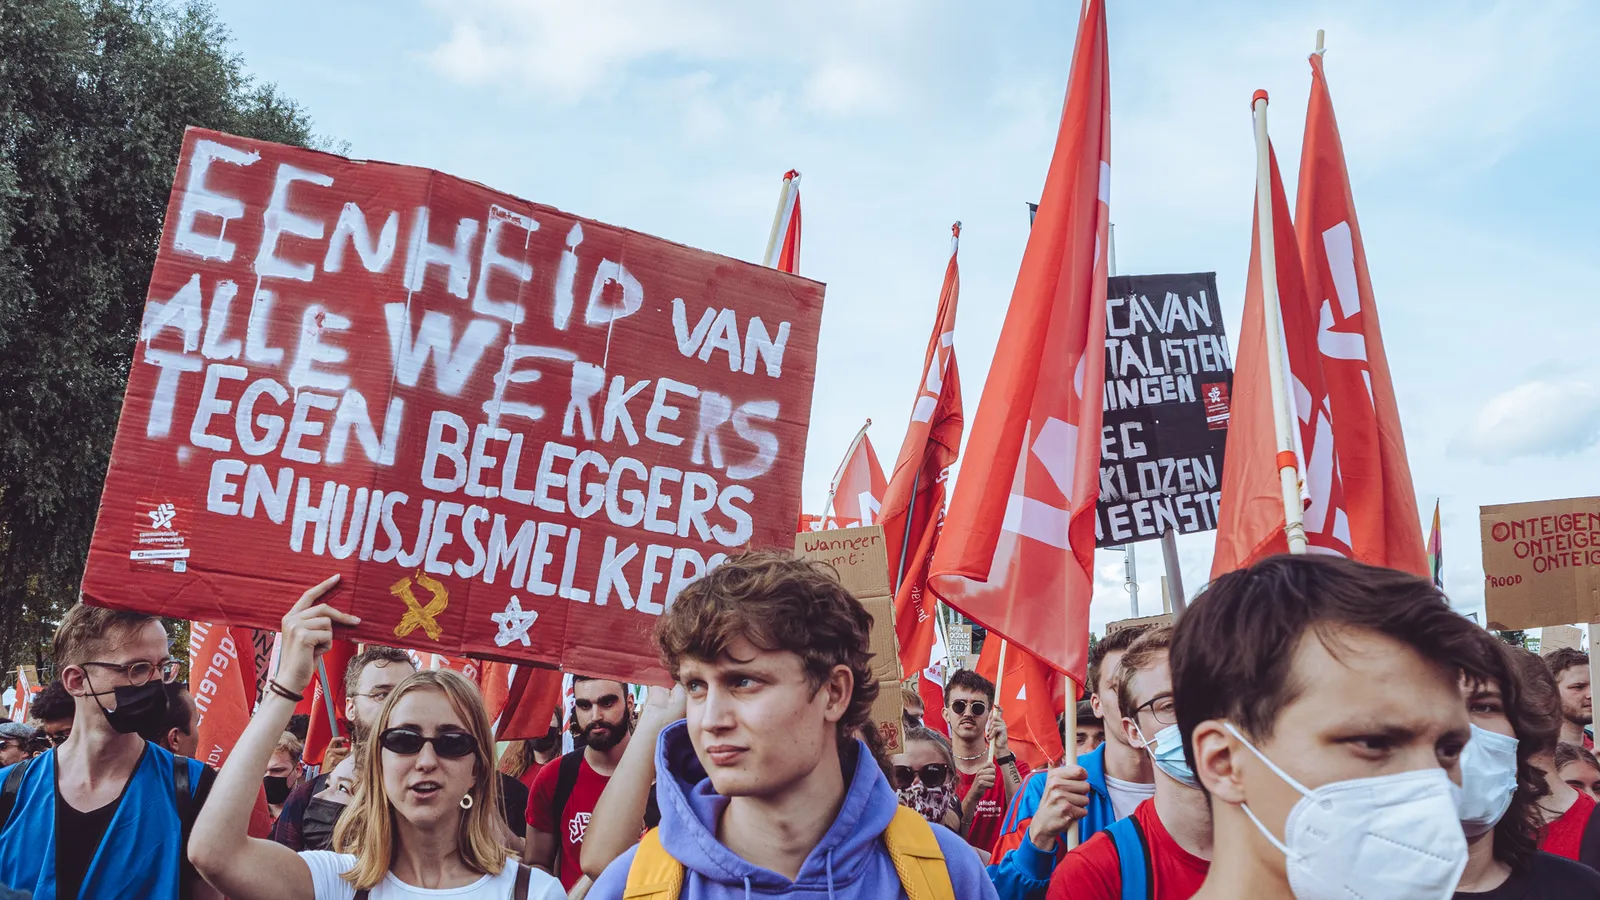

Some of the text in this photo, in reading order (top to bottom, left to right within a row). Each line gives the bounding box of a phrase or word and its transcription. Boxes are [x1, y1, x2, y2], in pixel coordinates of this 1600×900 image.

[672, 297, 790, 378] VAN
[1104, 334, 1232, 378] TALISTEN
[140, 272, 781, 480] ALLE WERKERS
[144, 348, 755, 547] TEGEN BELEGGERS
[1101, 421, 1147, 461] EG
[1098, 455, 1217, 502] KLOZEN
[1095, 491, 1221, 541] EENST
[1491, 512, 1600, 542] ONTEIGEN
[289, 476, 731, 616] HUISJESMELKER
[1513, 531, 1600, 559] ONTEIGE
